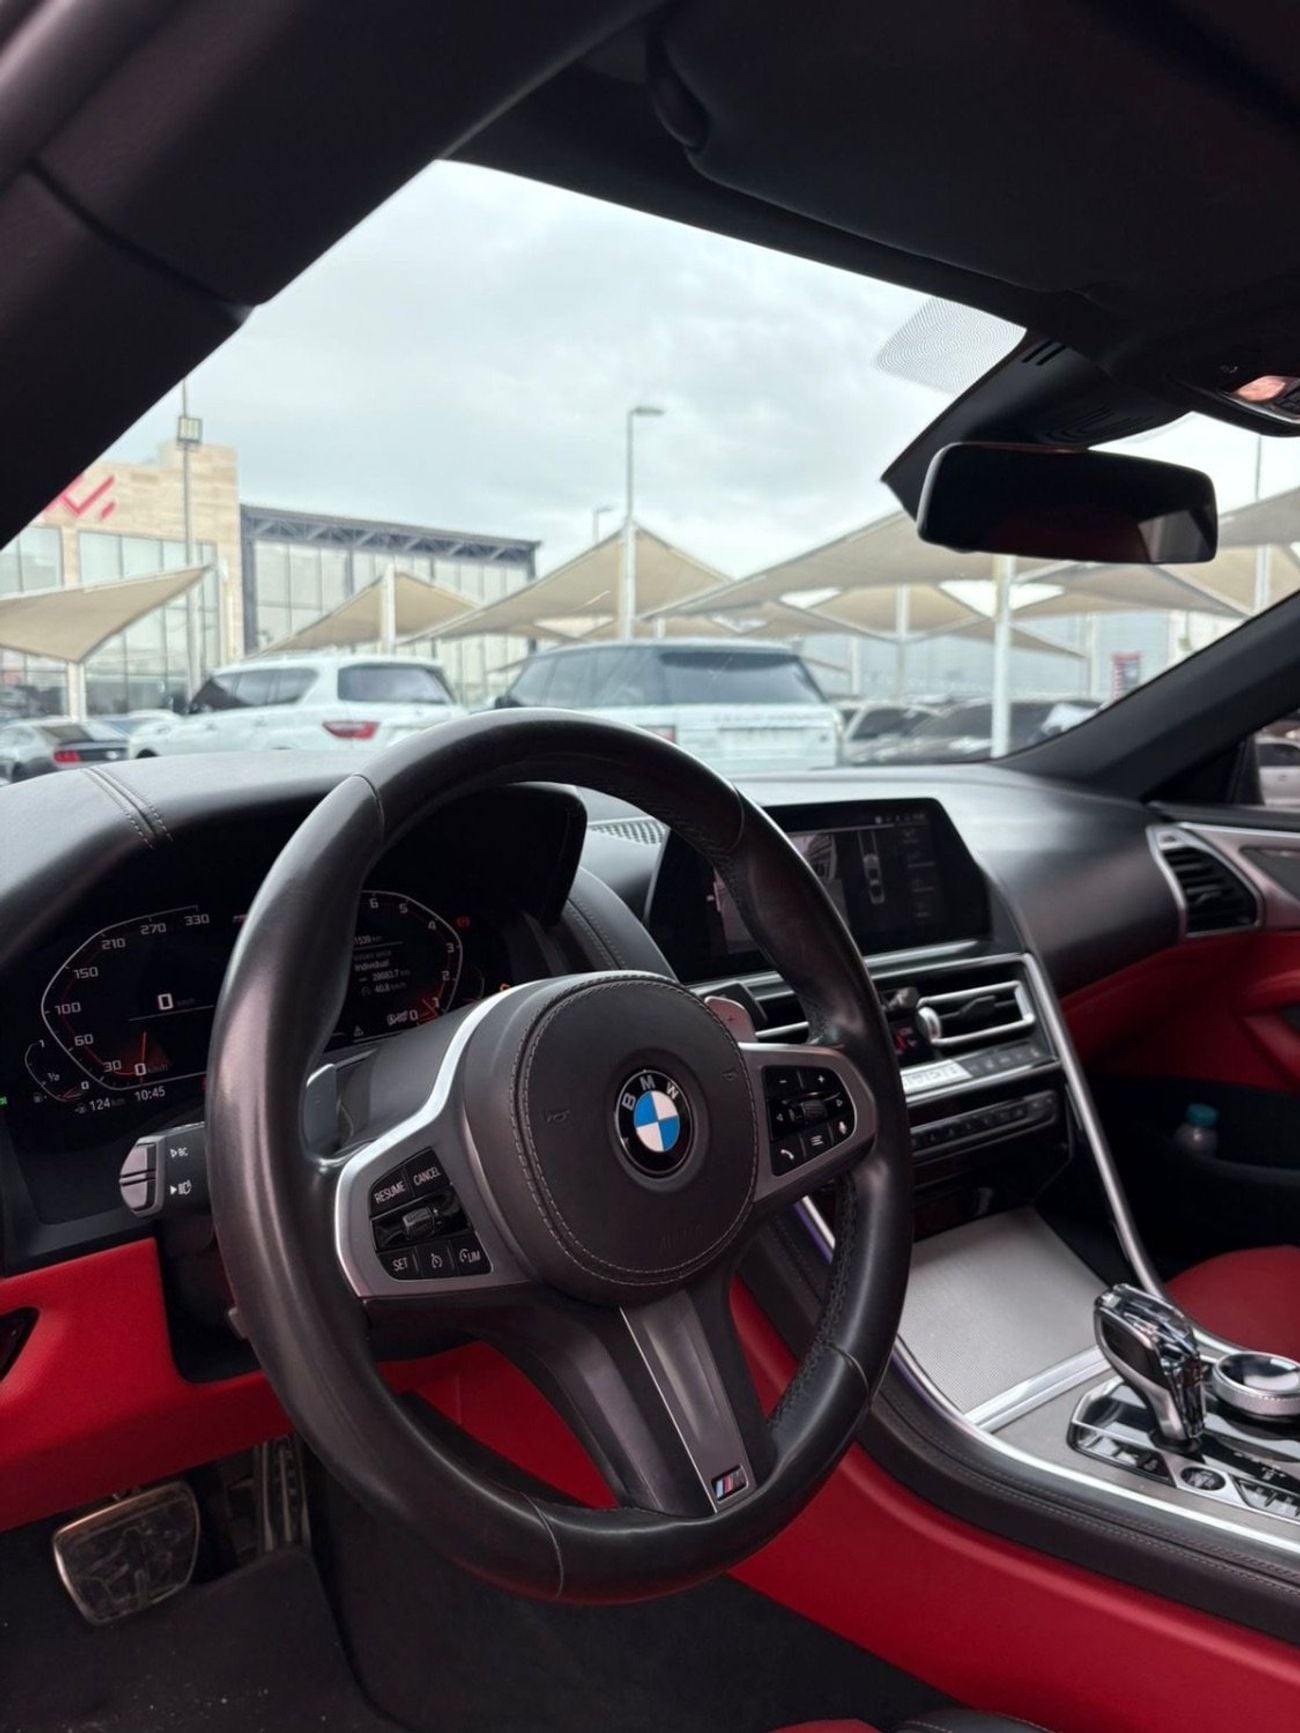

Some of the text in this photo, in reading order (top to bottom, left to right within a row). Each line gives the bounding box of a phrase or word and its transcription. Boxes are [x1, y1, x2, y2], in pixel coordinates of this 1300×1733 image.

[369, 898, 379, 909] 6
[399, 903, 408, 914] 5
[184, 913, 211, 927] 330
[428, 921, 437, 931] 4
[140, 922, 167, 936] 270
[101, 938, 126, 951] 210
[446, 942, 455, 953] 3
[74, 966, 99, 980] 150
[54, 1001, 81, 1015] 100
[157, 993, 174, 1011] 0
[74, 1033, 95, 1046] 60
[103, 1059, 122, 1073] 30
[133, 1063, 147, 1076] 0
[80, 1081, 90, 1090] 0
[620, 1074, 681, 1110] BMW
[134, 1086, 166, 1102] 10:45
[89, 1097, 111, 1111] 124
[413, 1166, 442, 1186] CANCEL
[373, 1180, 406, 1204] RESUME
[392, 1256, 409, 1271] SET
